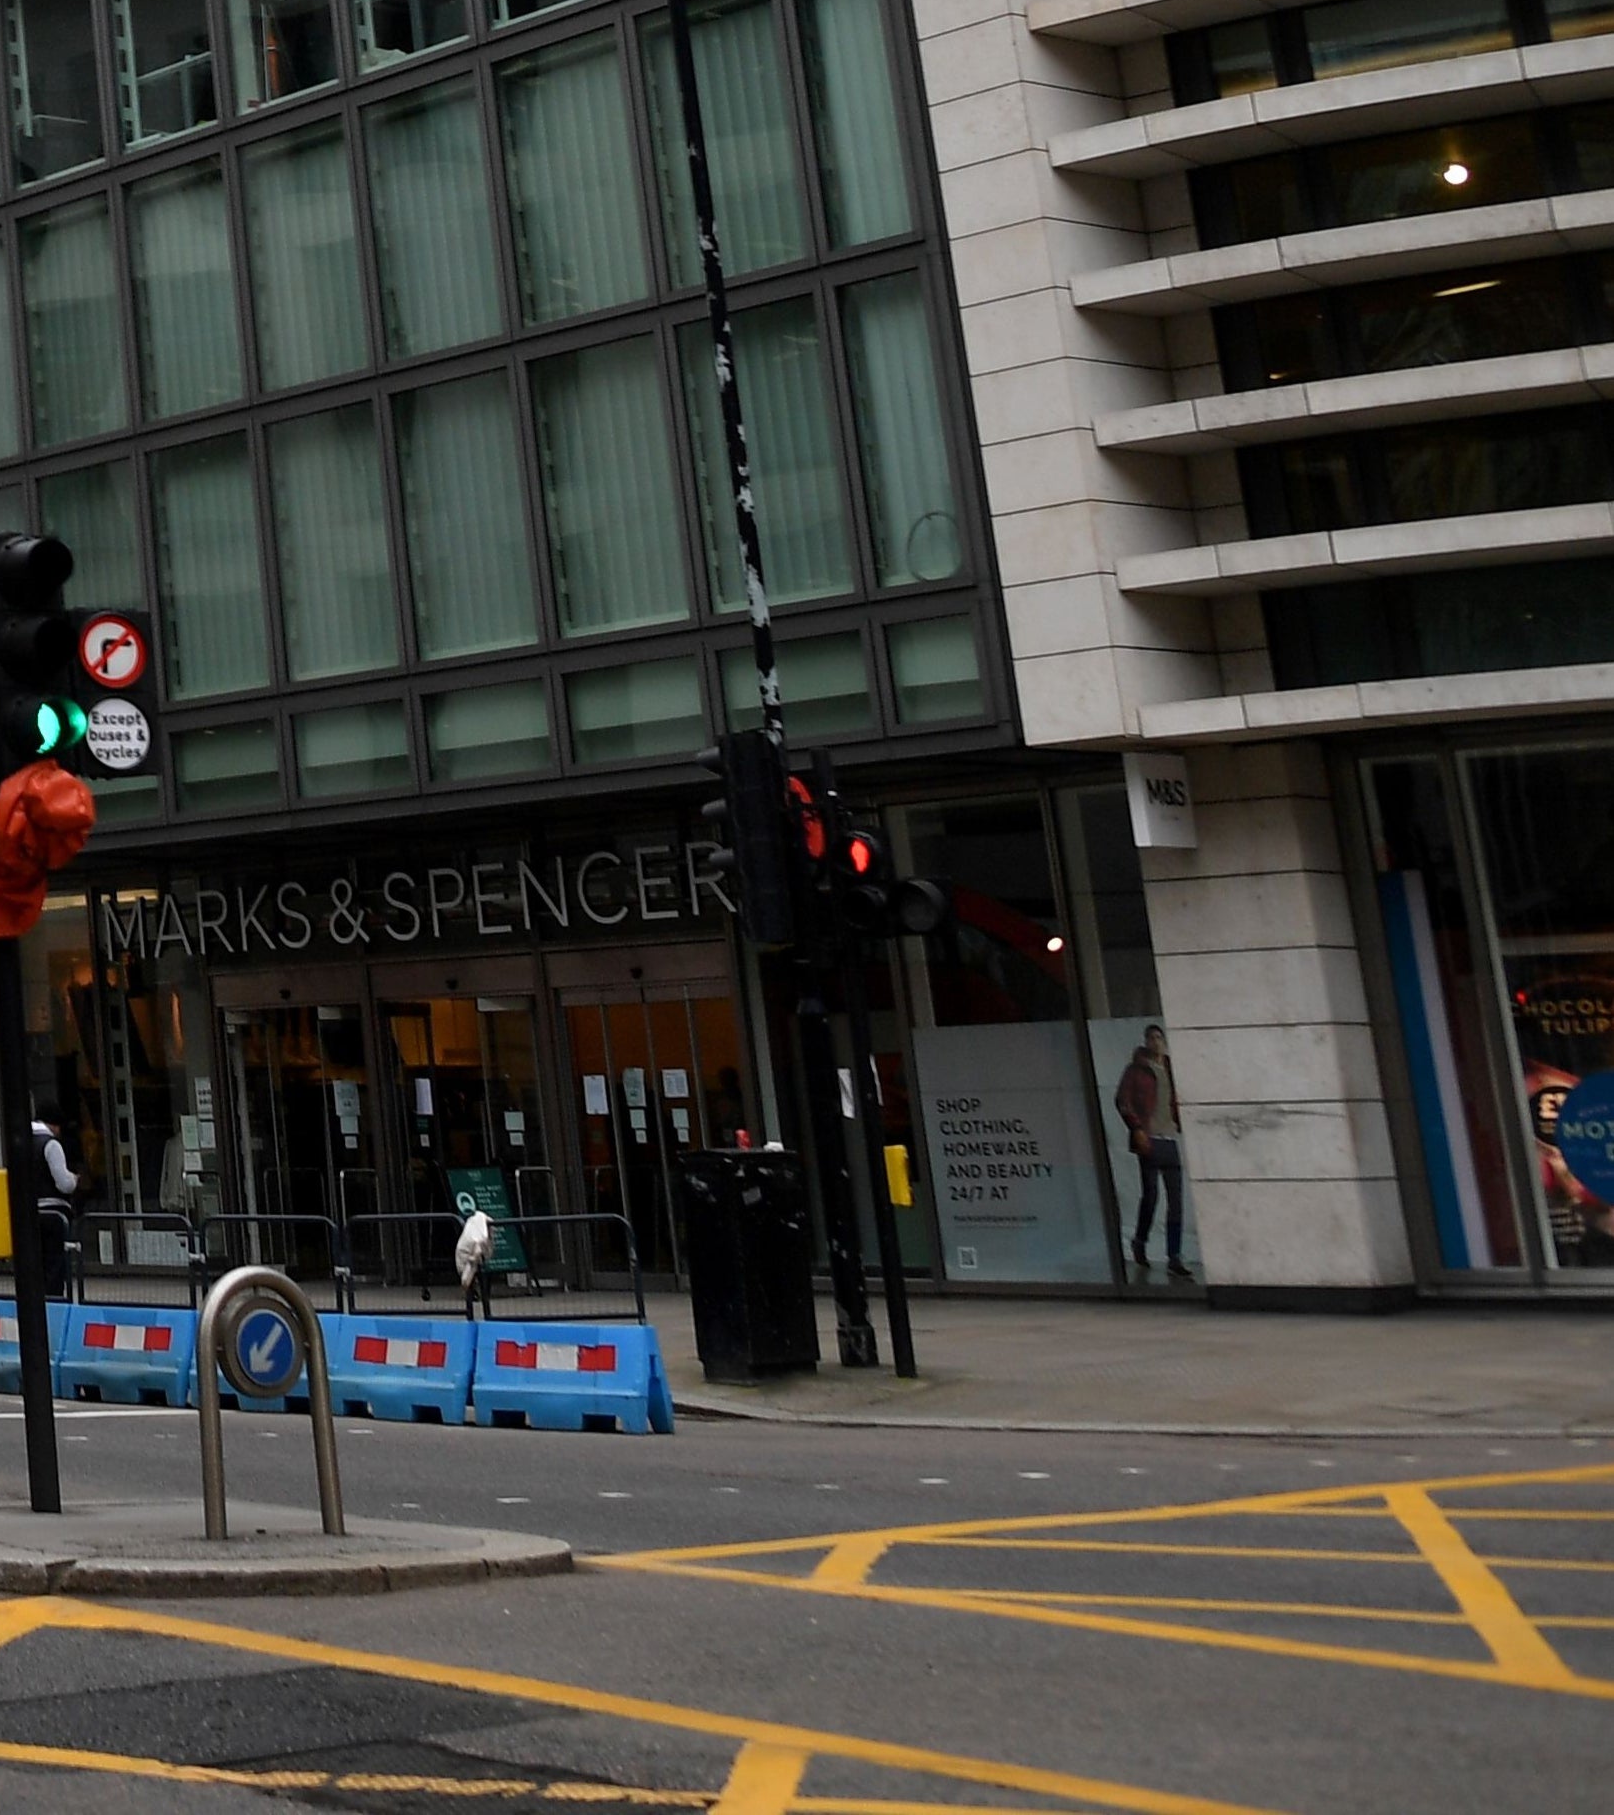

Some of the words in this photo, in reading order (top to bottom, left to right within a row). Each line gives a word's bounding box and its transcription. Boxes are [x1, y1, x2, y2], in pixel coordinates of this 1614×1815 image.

[90, 710, 142, 727] Except
[89, 727, 131, 741] buses
[136, 729, 147, 741] &
[95, 744, 142, 760] cycles
[1145, 777, 1186, 807] M&S
[100, 881, 312, 962] MARKS
[328, 878, 371, 945] &
[383, 840, 737, 943] SPENCER
[936, 1097, 982, 1114] SHOP
[943, 1141, 1041, 1157] HOMEWARE
[946, 1163, 982, 1179] AND
[986, 1162, 1054, 1178] BEAUTY
[949, 1186, 983, 1202] 24/7
[990, 1186, 1010, 1201] AT
